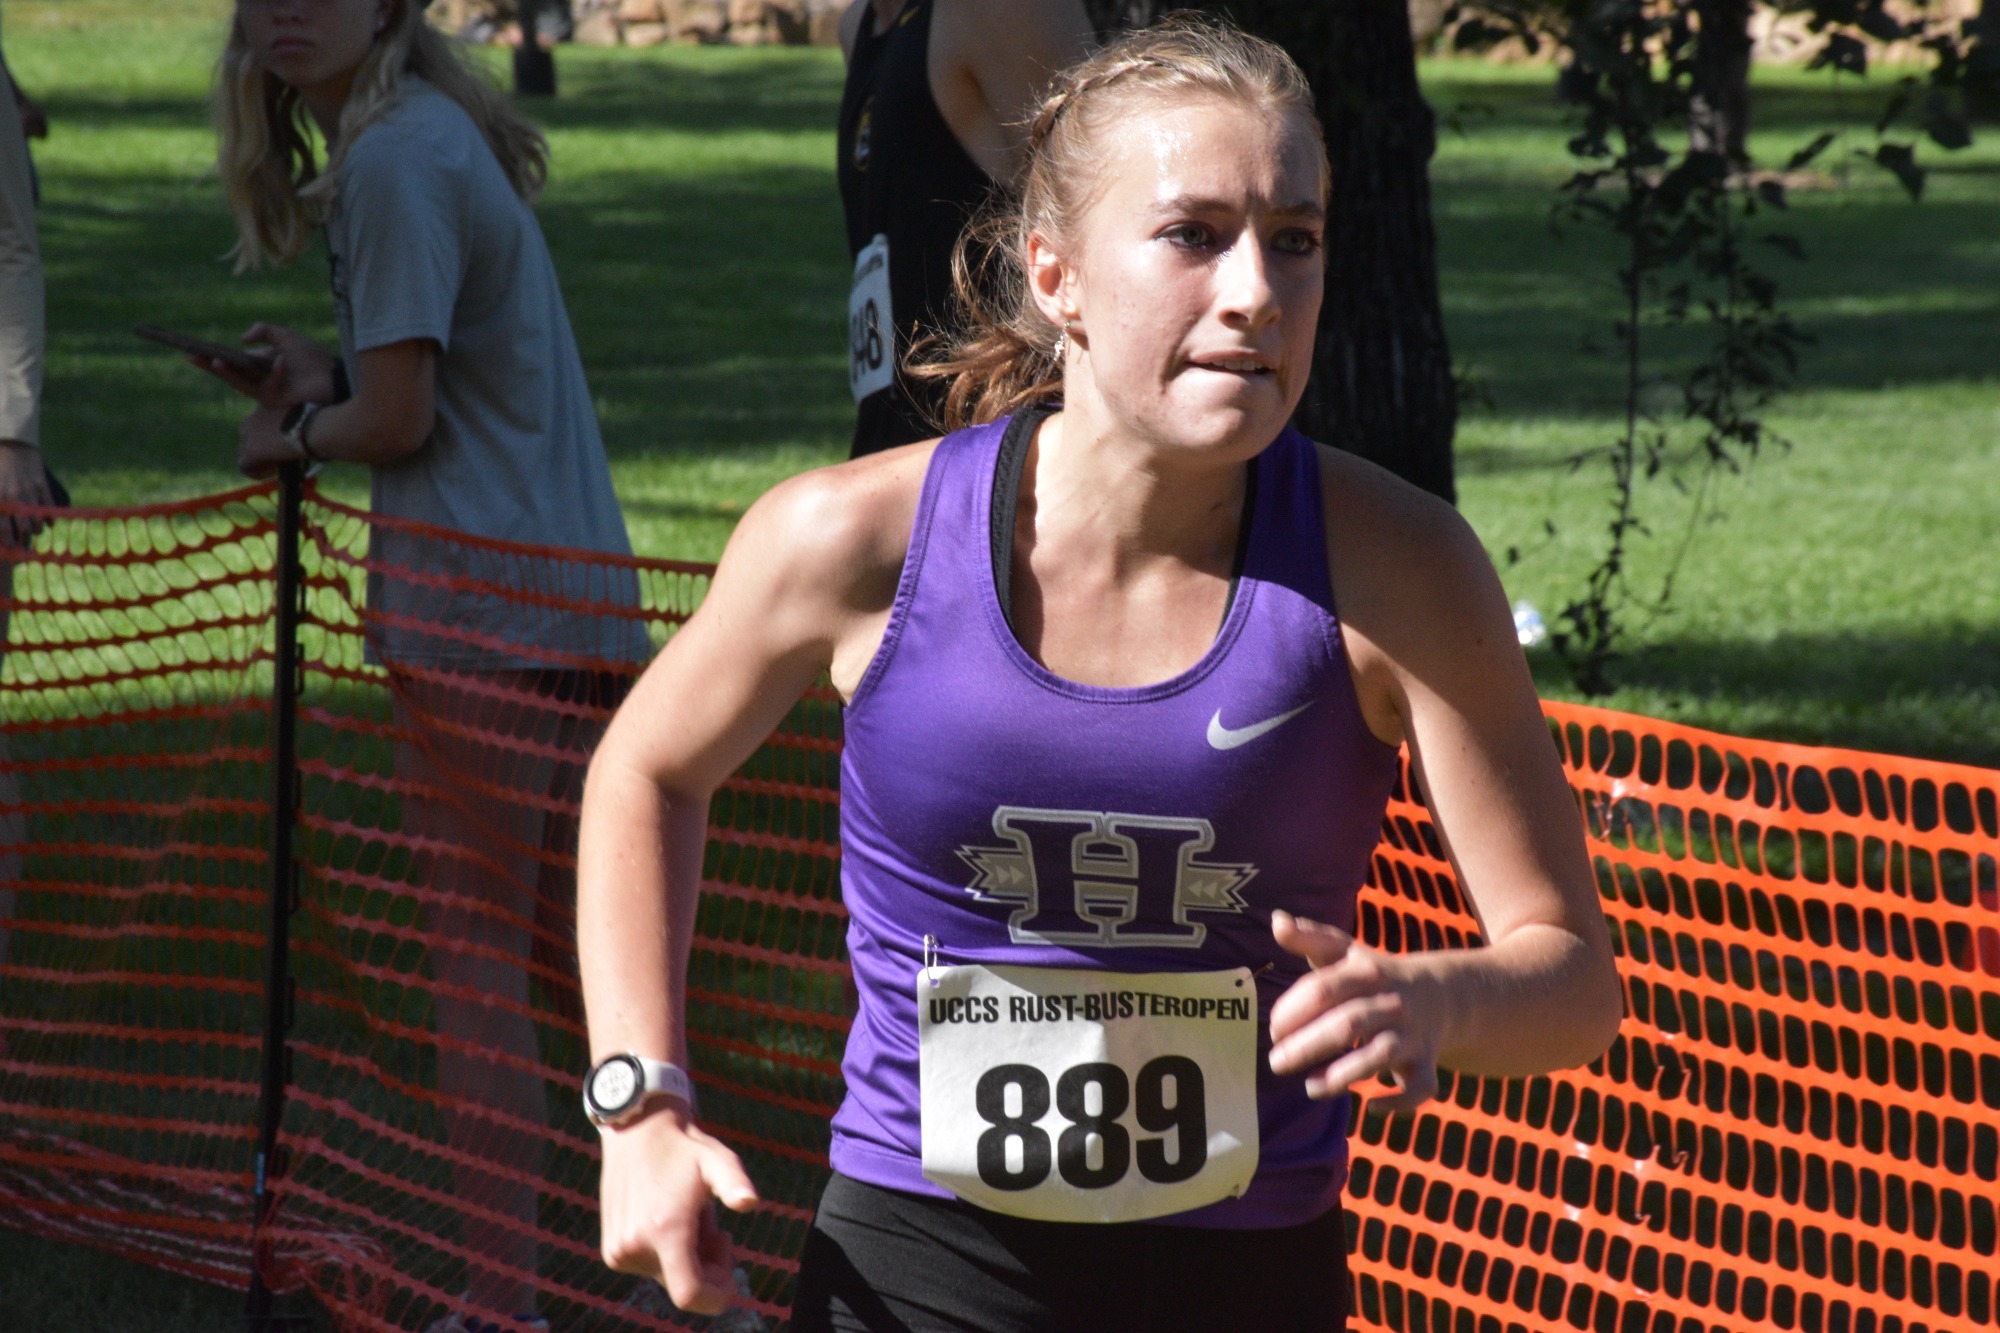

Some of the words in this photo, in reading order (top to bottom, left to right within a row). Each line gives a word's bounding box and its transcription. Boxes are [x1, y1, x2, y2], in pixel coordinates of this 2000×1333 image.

[991, 805, 1216, 948] H
[929, 996, 999, 1024] UCCS
[975, 1055, 1207, 1191] 889
